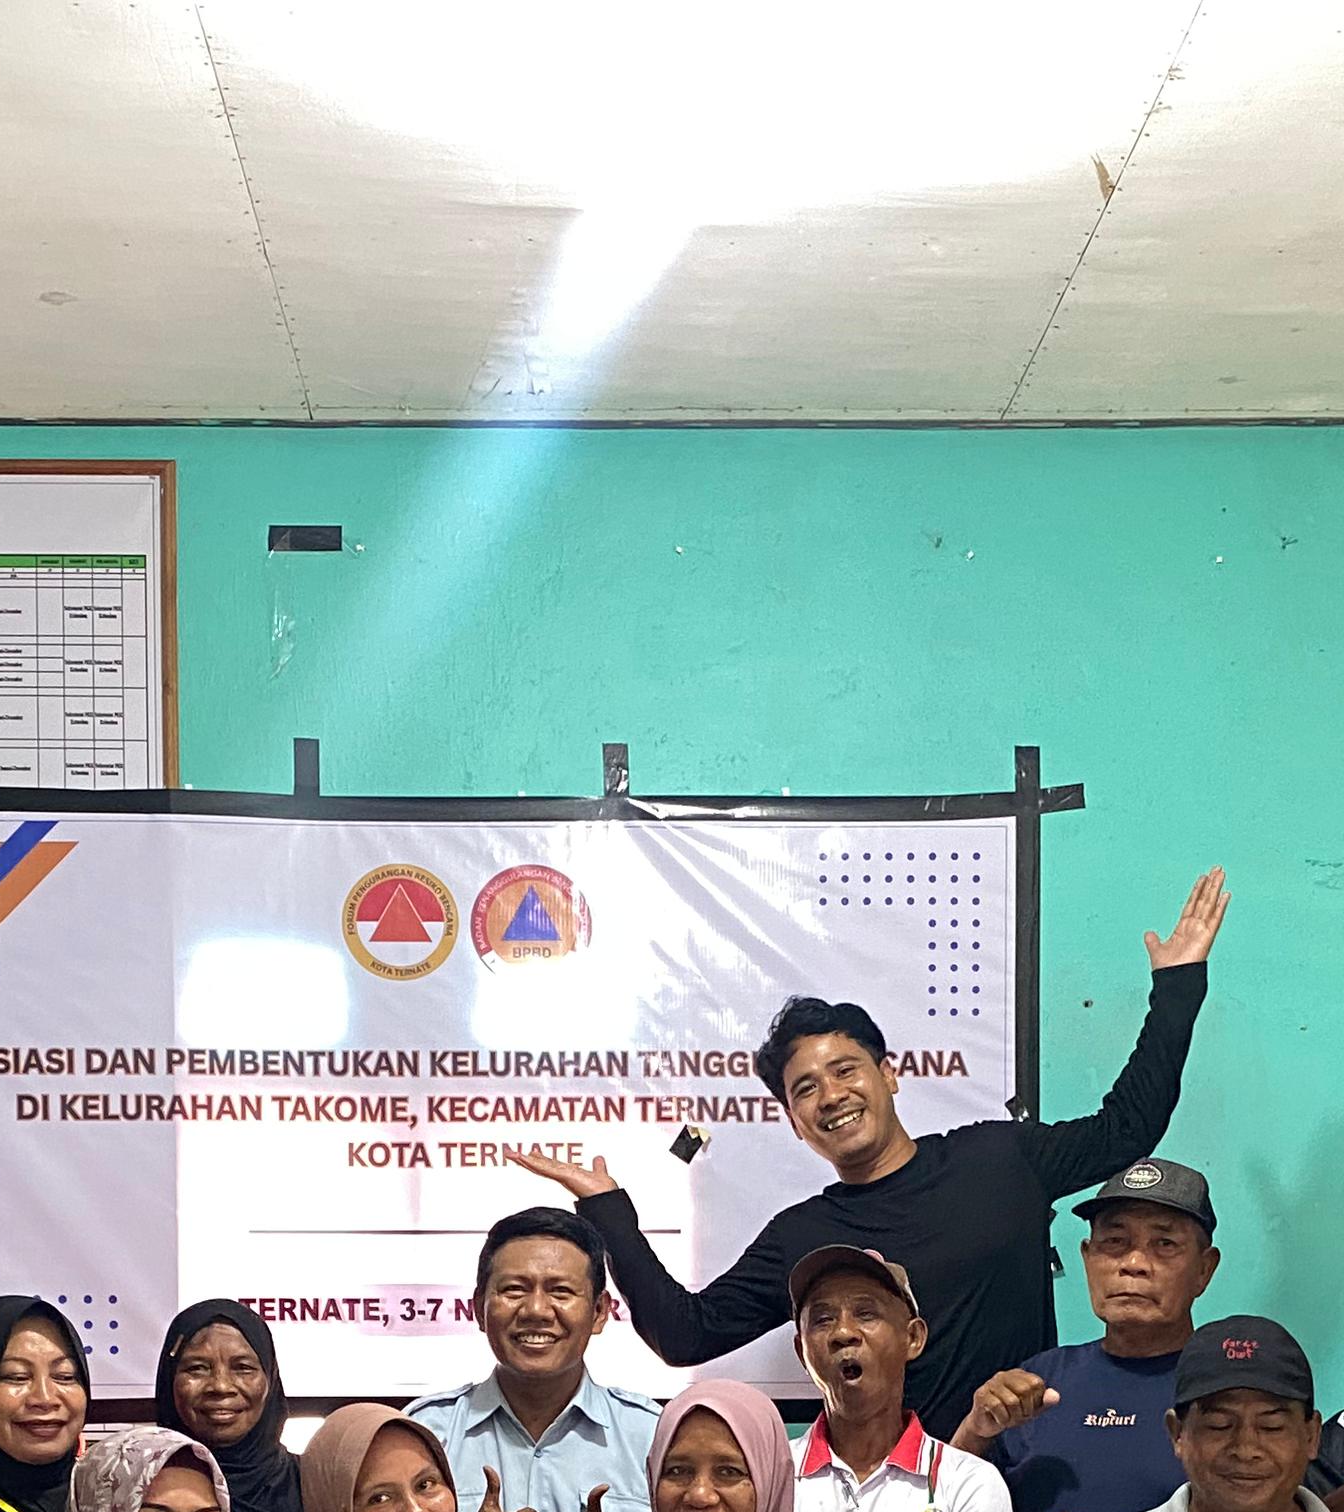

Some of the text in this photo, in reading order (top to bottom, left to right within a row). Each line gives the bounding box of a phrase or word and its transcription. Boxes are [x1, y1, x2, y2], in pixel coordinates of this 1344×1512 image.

[84, 1048, 154, 1075] DAN
[166, 1049, 420, 1077] PEMBENTUKAN
[430, 1050, 628, 1078] KELURAHAN
[16, 1093, 780, 1130] DI KELURAHAN TAKOME, KECAMATAN TERNATE
[348, 1142, 433, 1168] KOTA
[238, 1298, 390, 1327] TERNATE,
[400, 1298, 444, 1322] 3-7
